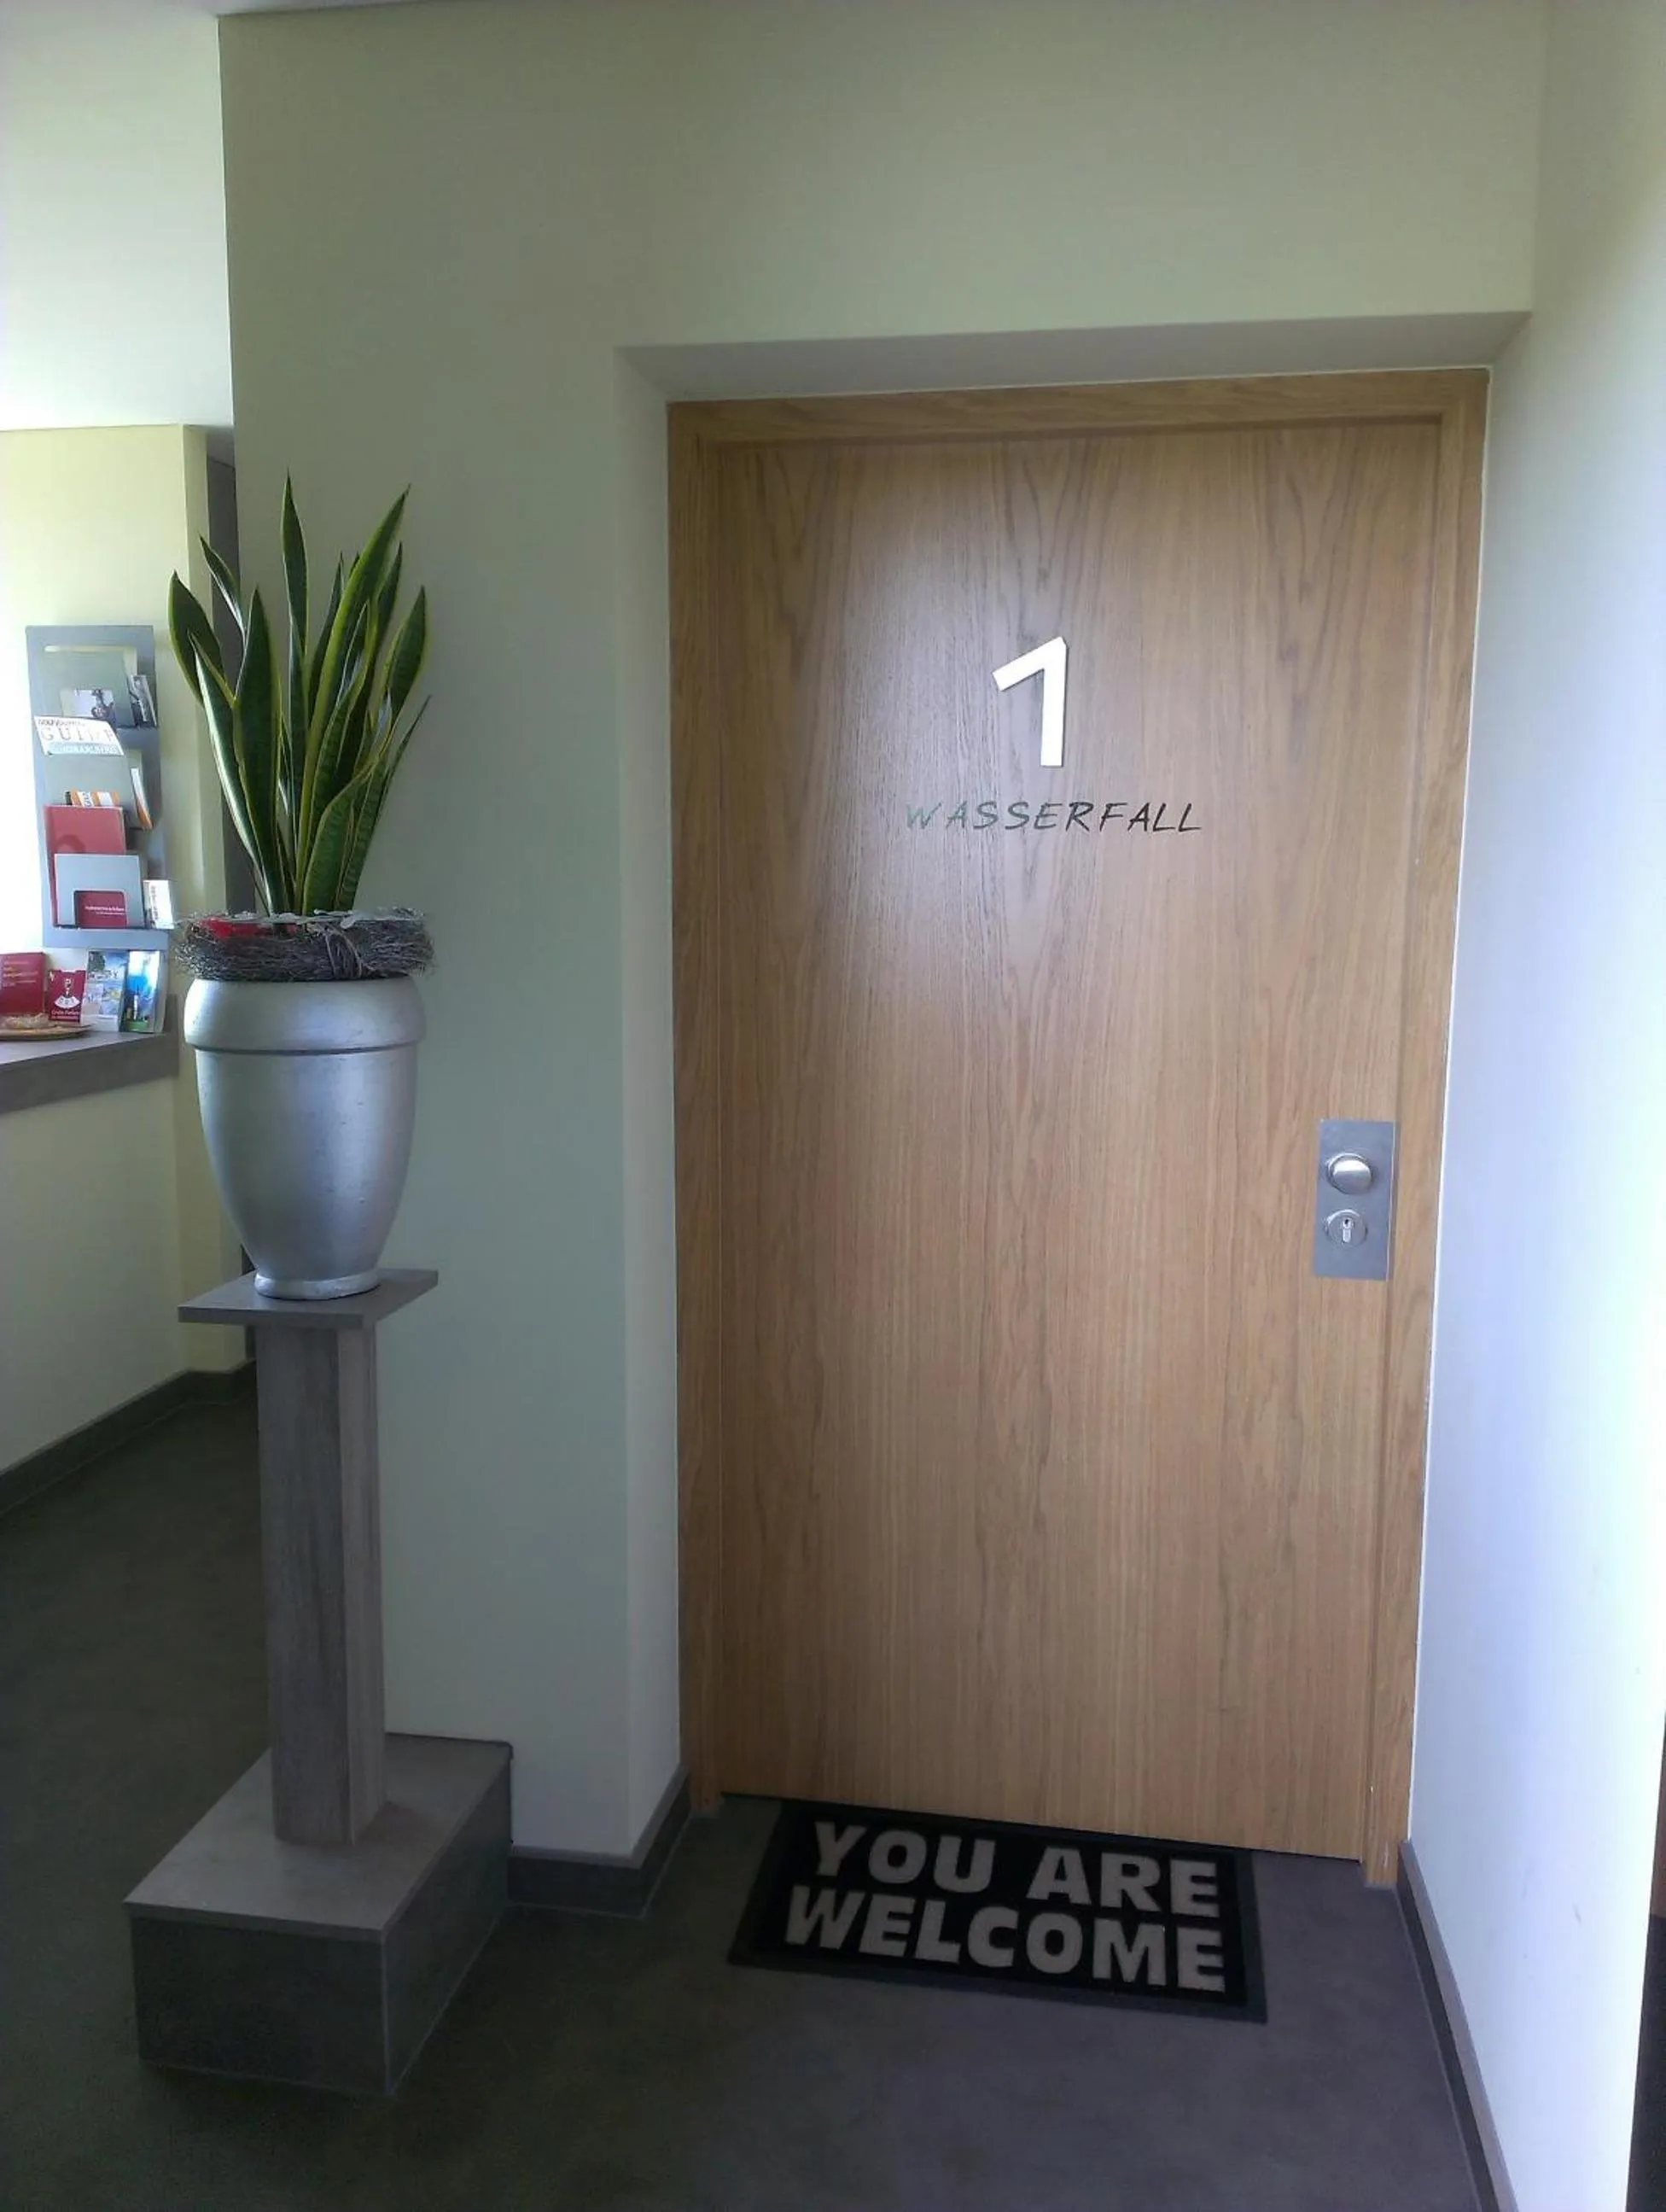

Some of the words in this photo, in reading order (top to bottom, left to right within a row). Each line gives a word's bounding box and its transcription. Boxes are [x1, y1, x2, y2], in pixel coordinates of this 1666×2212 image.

[991, 635, 1068, 767] 1
[905, 799, 1203, 833] WASSERFALL
[813, 1820, 997, 1894] YOU
[1025, 1846, 1220, 1918] ARE
[783, 1884, 1226, 1993] WELCOME
